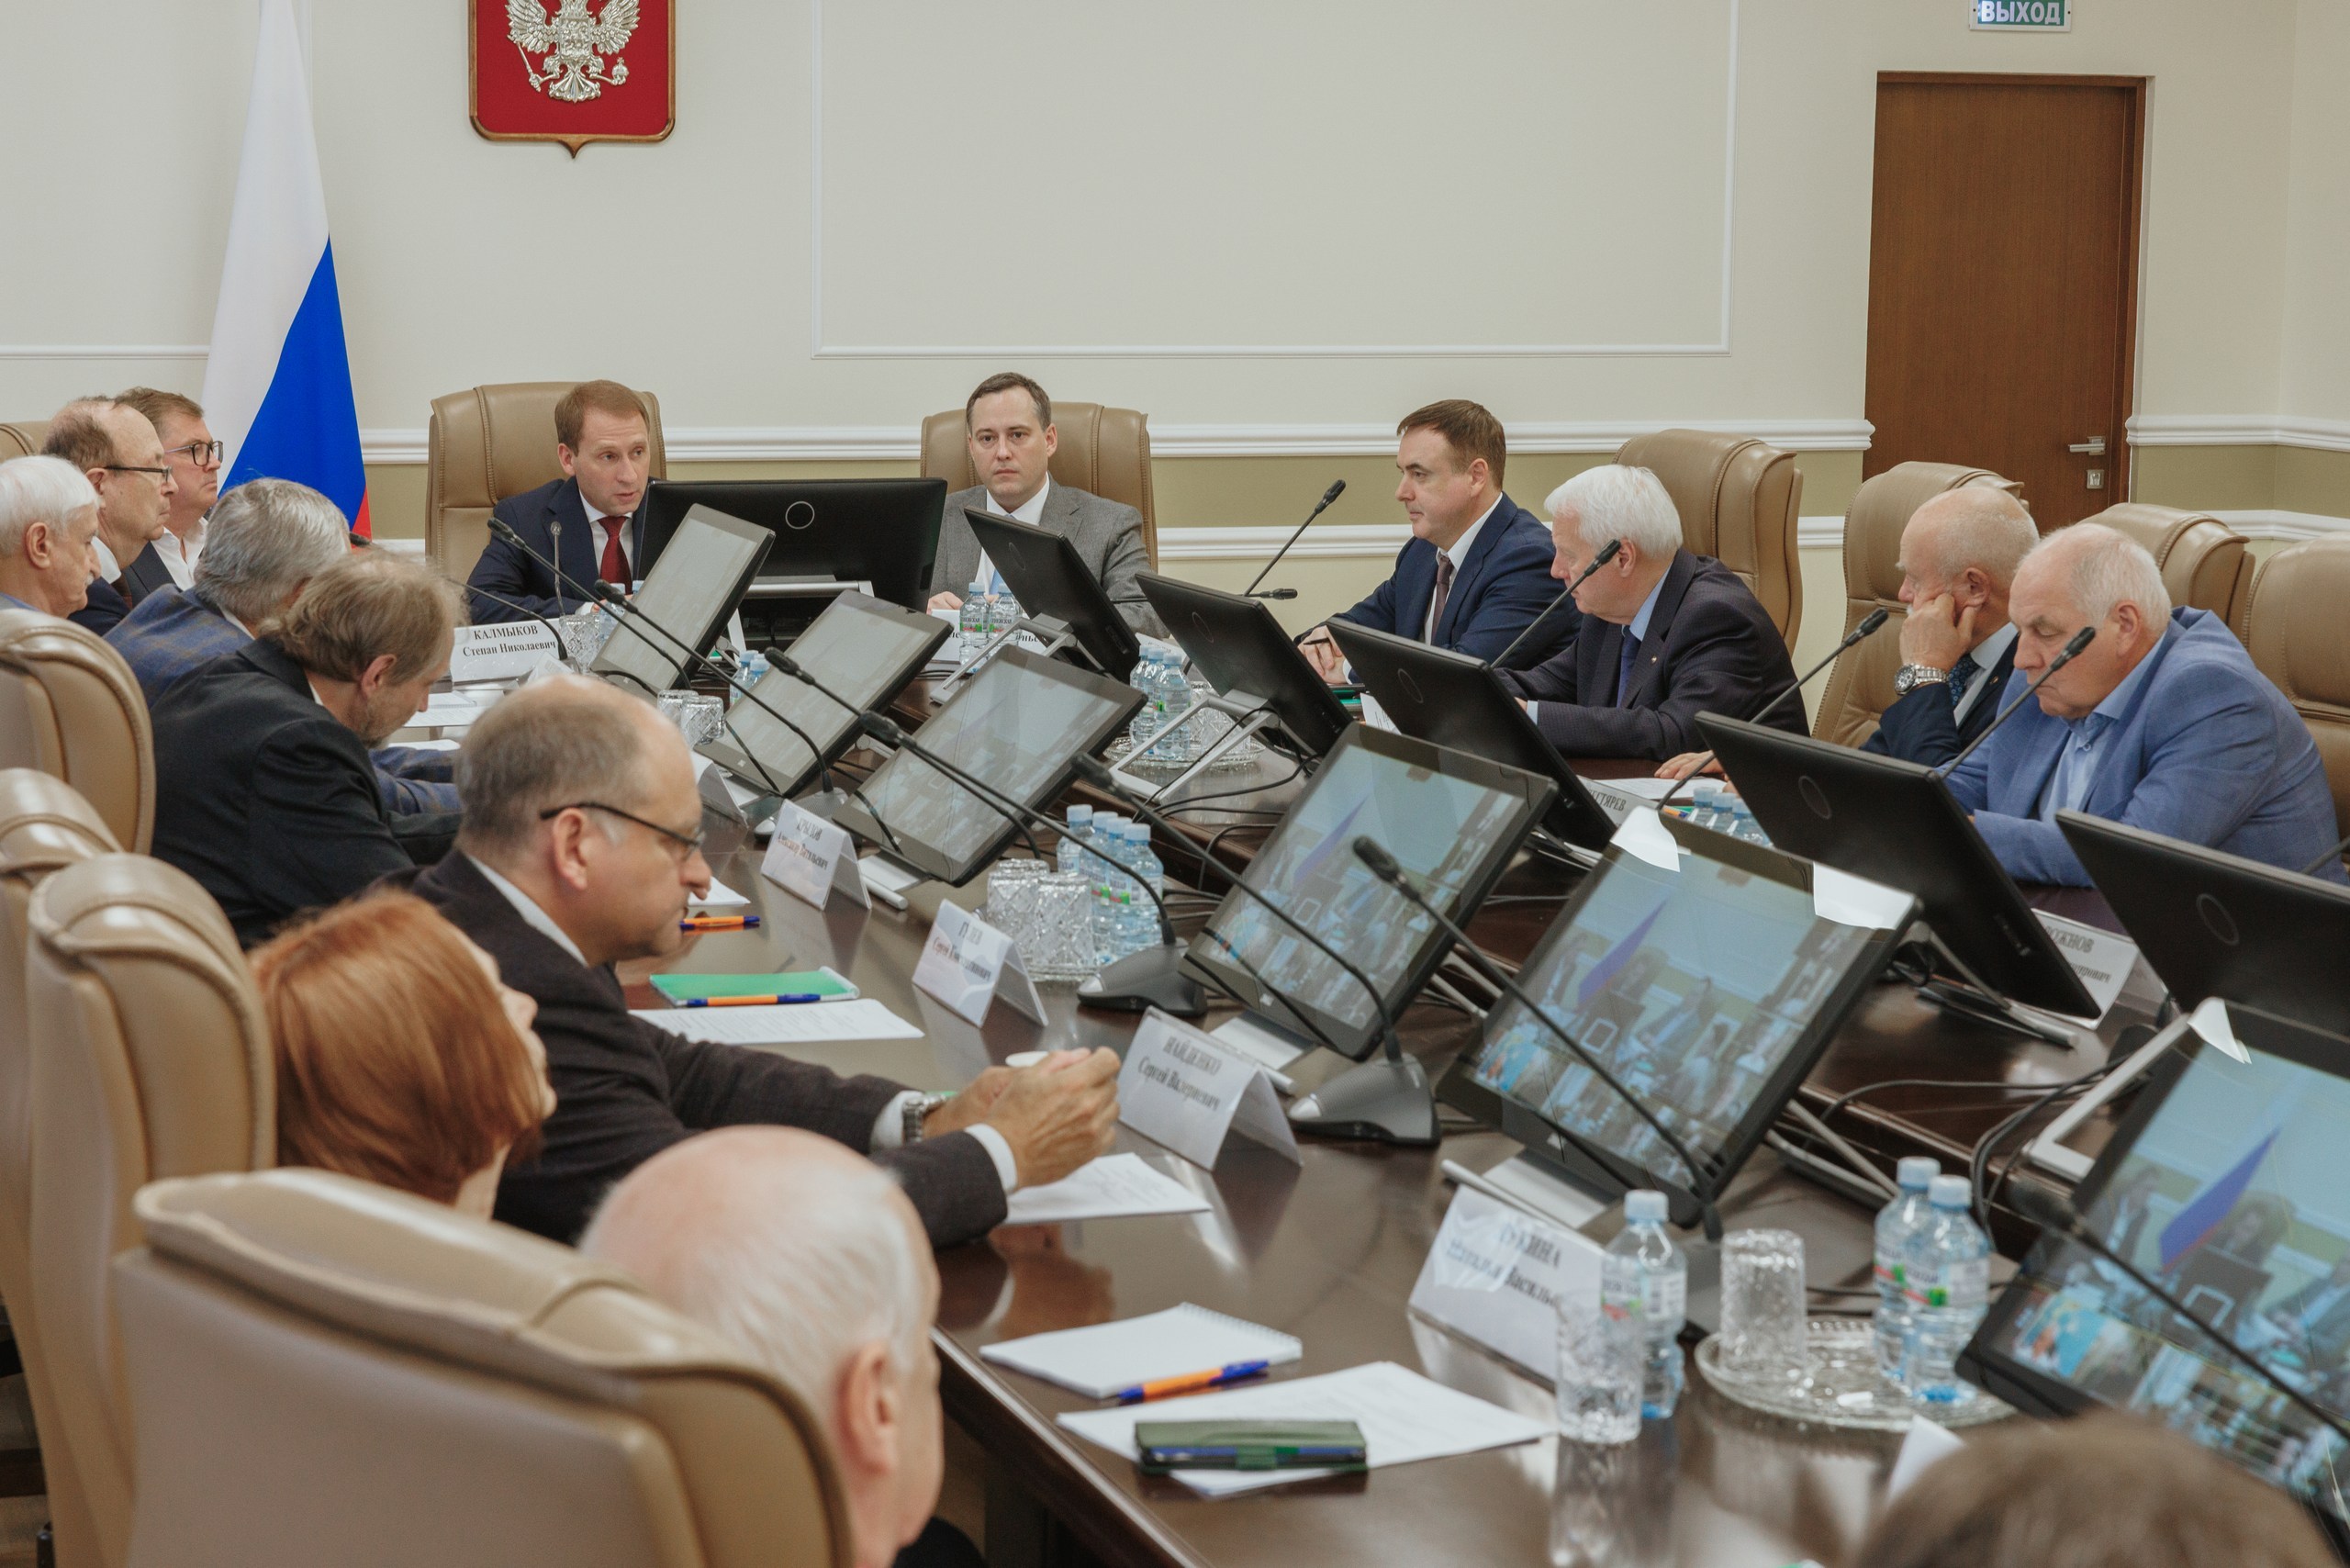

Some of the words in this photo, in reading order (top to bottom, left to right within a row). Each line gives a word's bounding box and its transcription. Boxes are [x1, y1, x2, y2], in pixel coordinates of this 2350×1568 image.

[1981, 1, 2061, 25] ВЫХОД
[474, 625, 538, 640] КАЛМЫКОВ
[463, 645, 498, 657] Степан
[500, 641, 556, 654] Николаевич
